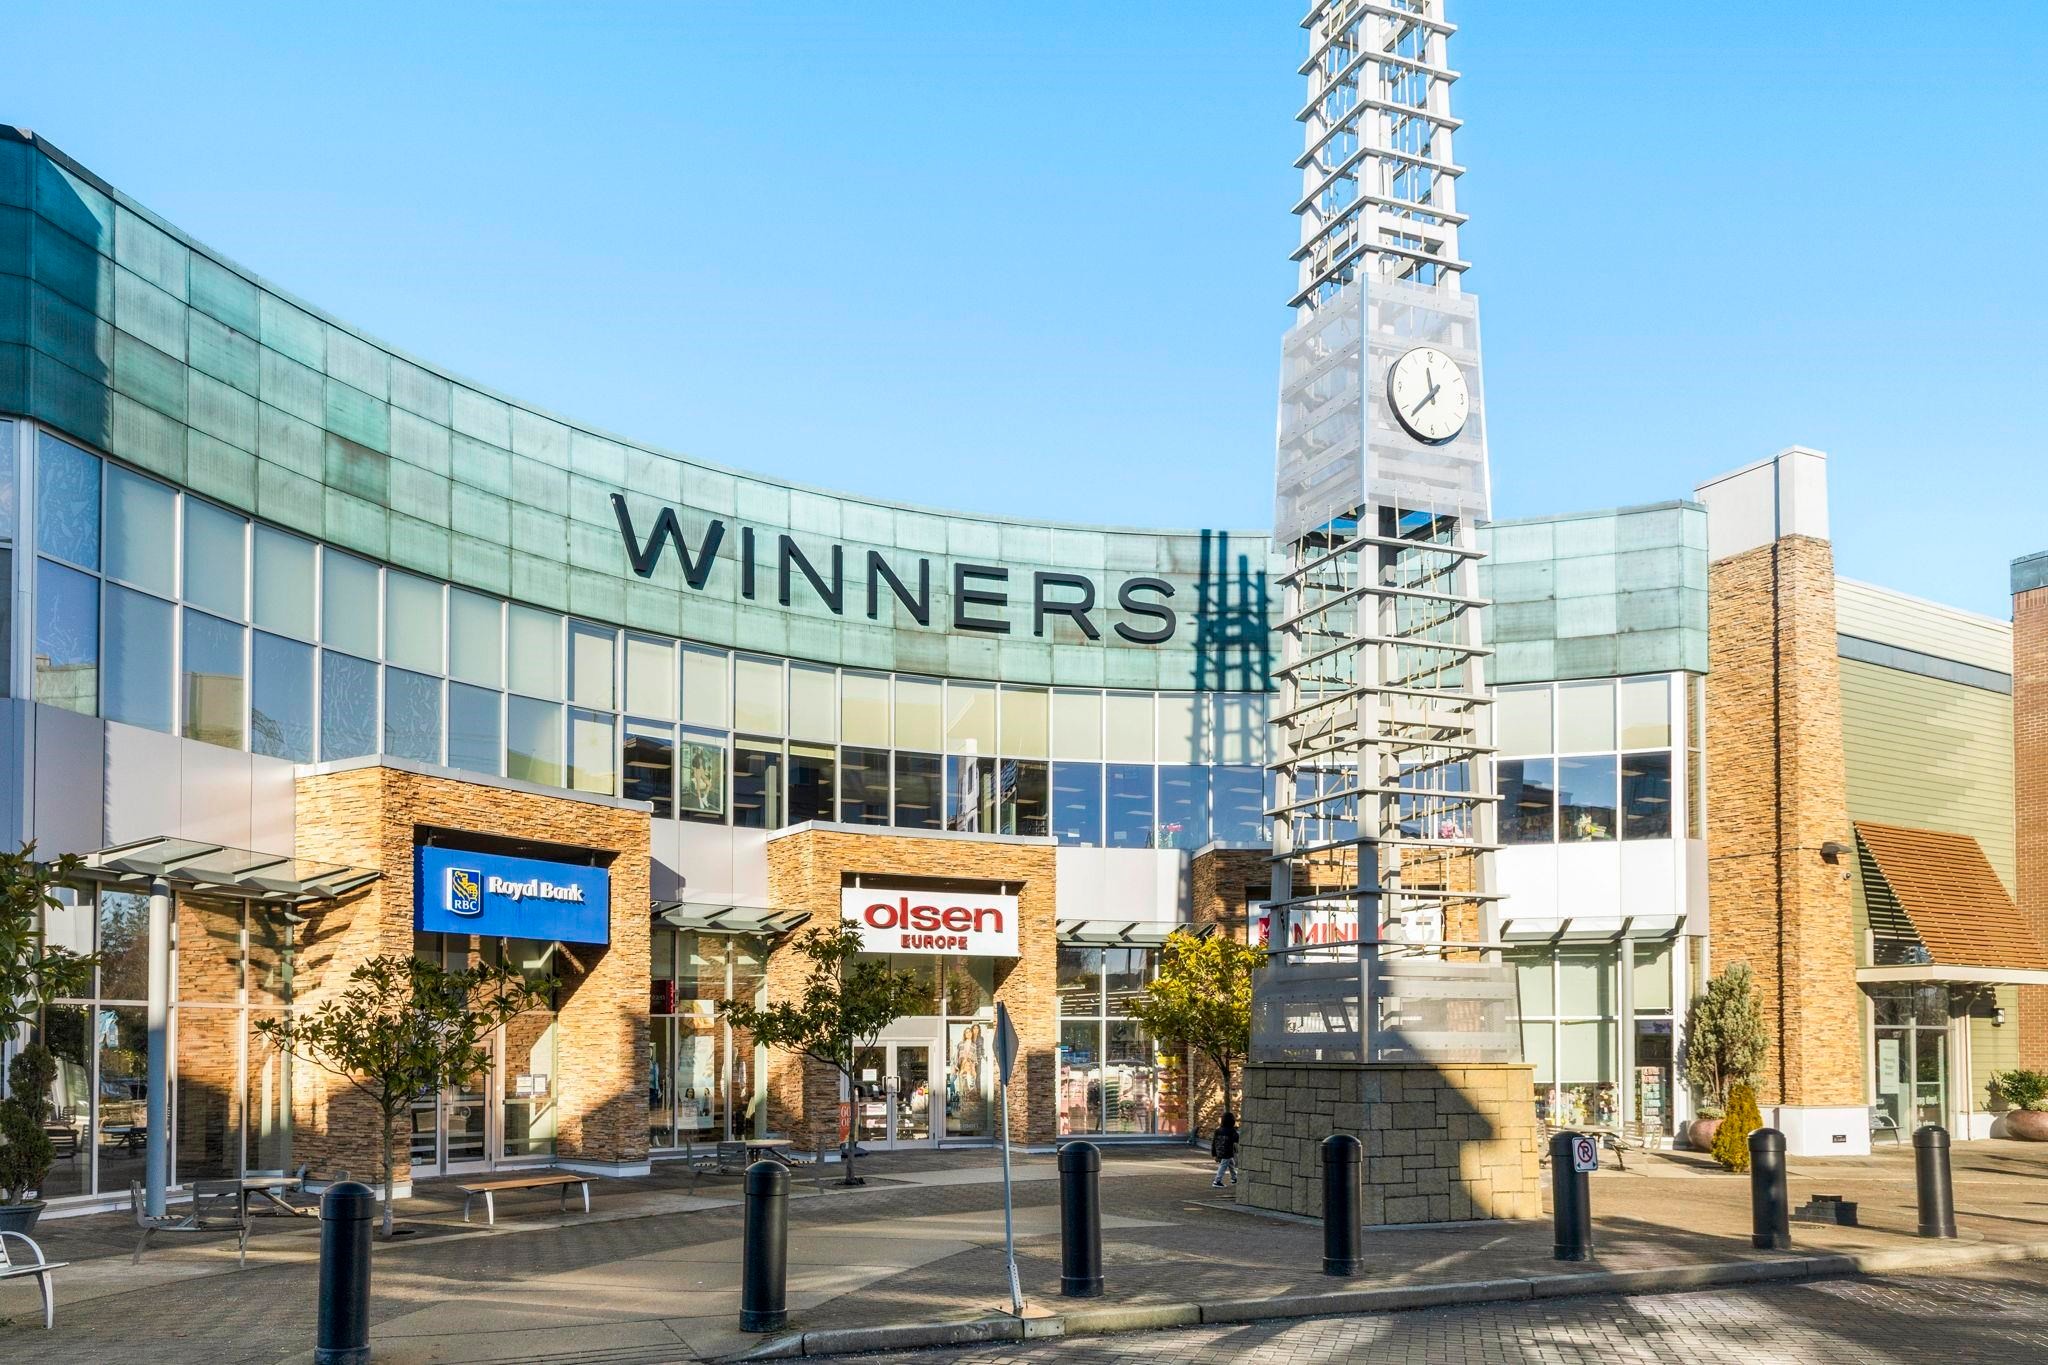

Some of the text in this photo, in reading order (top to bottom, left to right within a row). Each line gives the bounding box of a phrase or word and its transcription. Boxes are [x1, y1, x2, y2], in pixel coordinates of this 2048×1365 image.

[1426, 351, 1434, 363] 12
[1398, 381, 1402, 392] 9
[1459, 393, 1464, 405] 3
[1430, 424, 1435, 436] 6
[610, 493, 1176, 644] WINNERS
[488, 876, 584, 902] Royal Bank
[454, 899, 478, 911] RBC
[864, 897, 1004, 934] olsen
[1293, 922, 1385, 943] MINI
[900, 934, 968, 950] EUROPE
